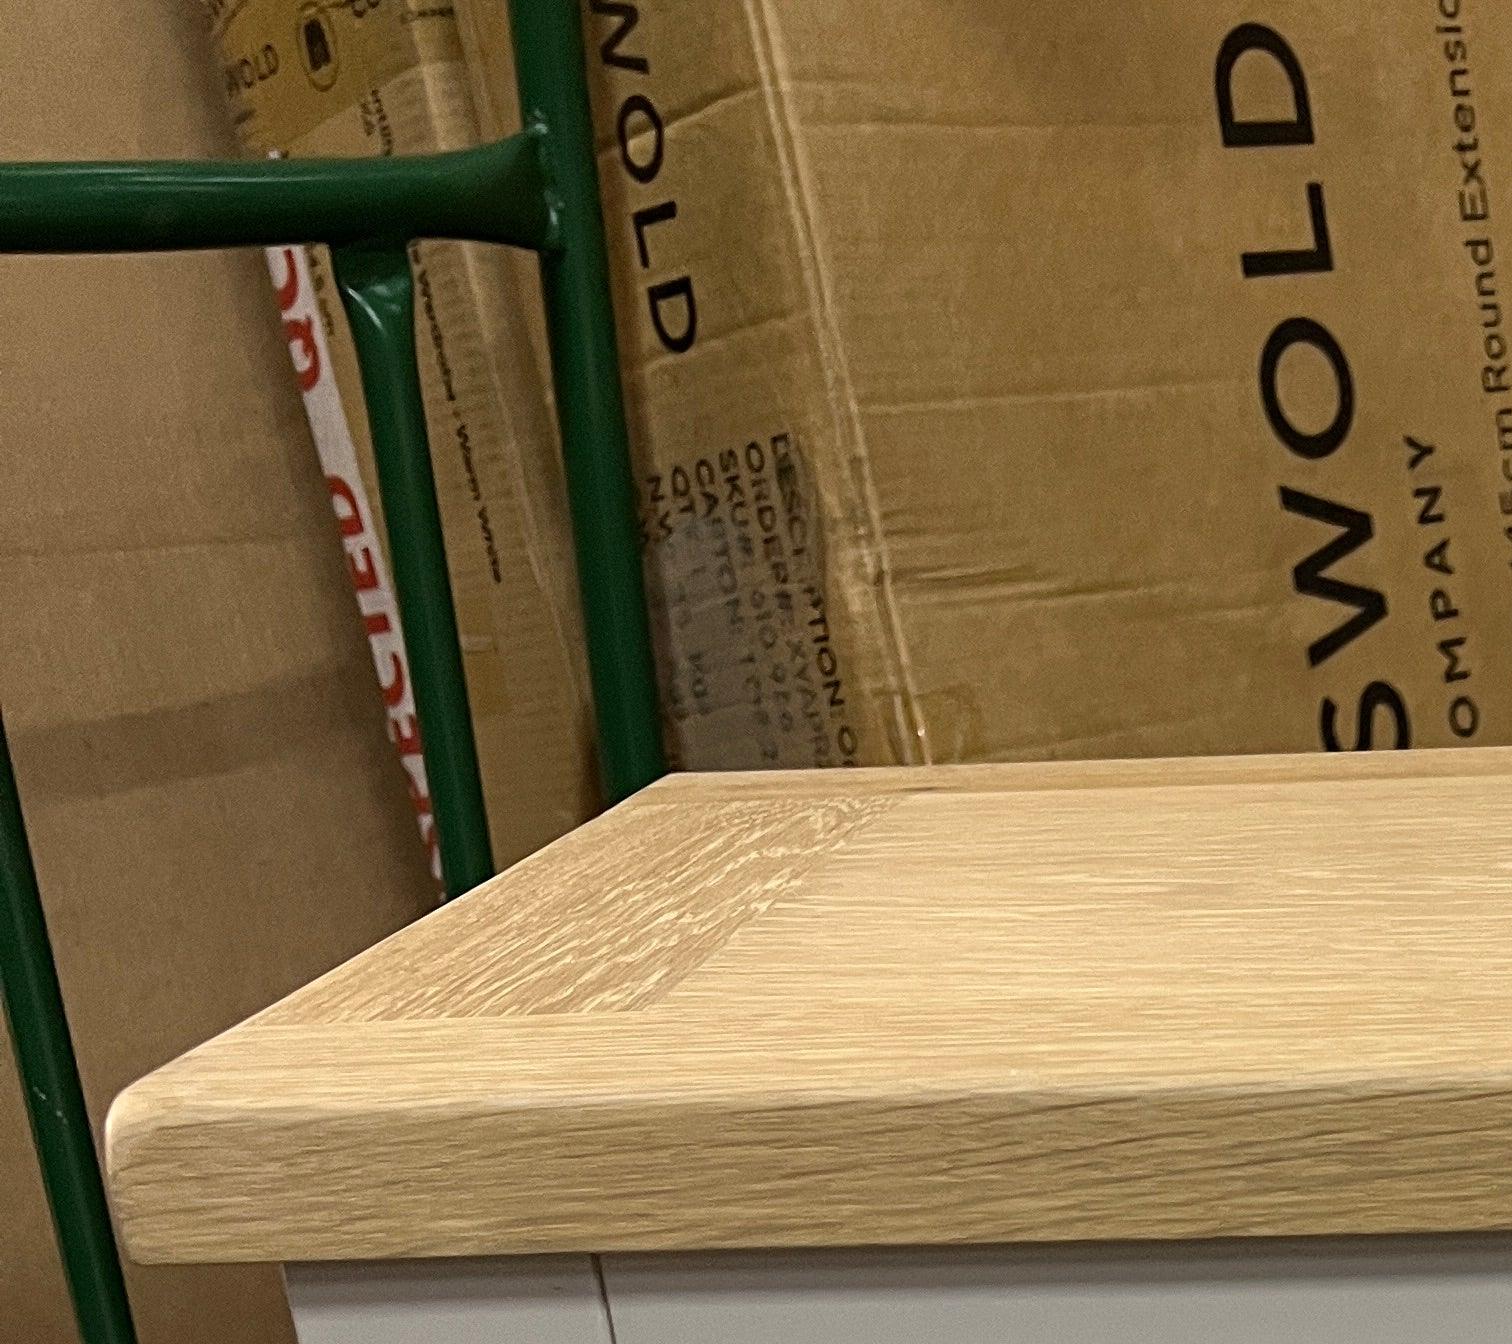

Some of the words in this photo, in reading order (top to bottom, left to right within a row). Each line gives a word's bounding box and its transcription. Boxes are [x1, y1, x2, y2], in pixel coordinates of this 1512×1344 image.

[1214, 22, 1411, 750] SWOLD
[1461, 236, 1511, 396] Round
[1404, 434, 1480, 738] OMPANY
